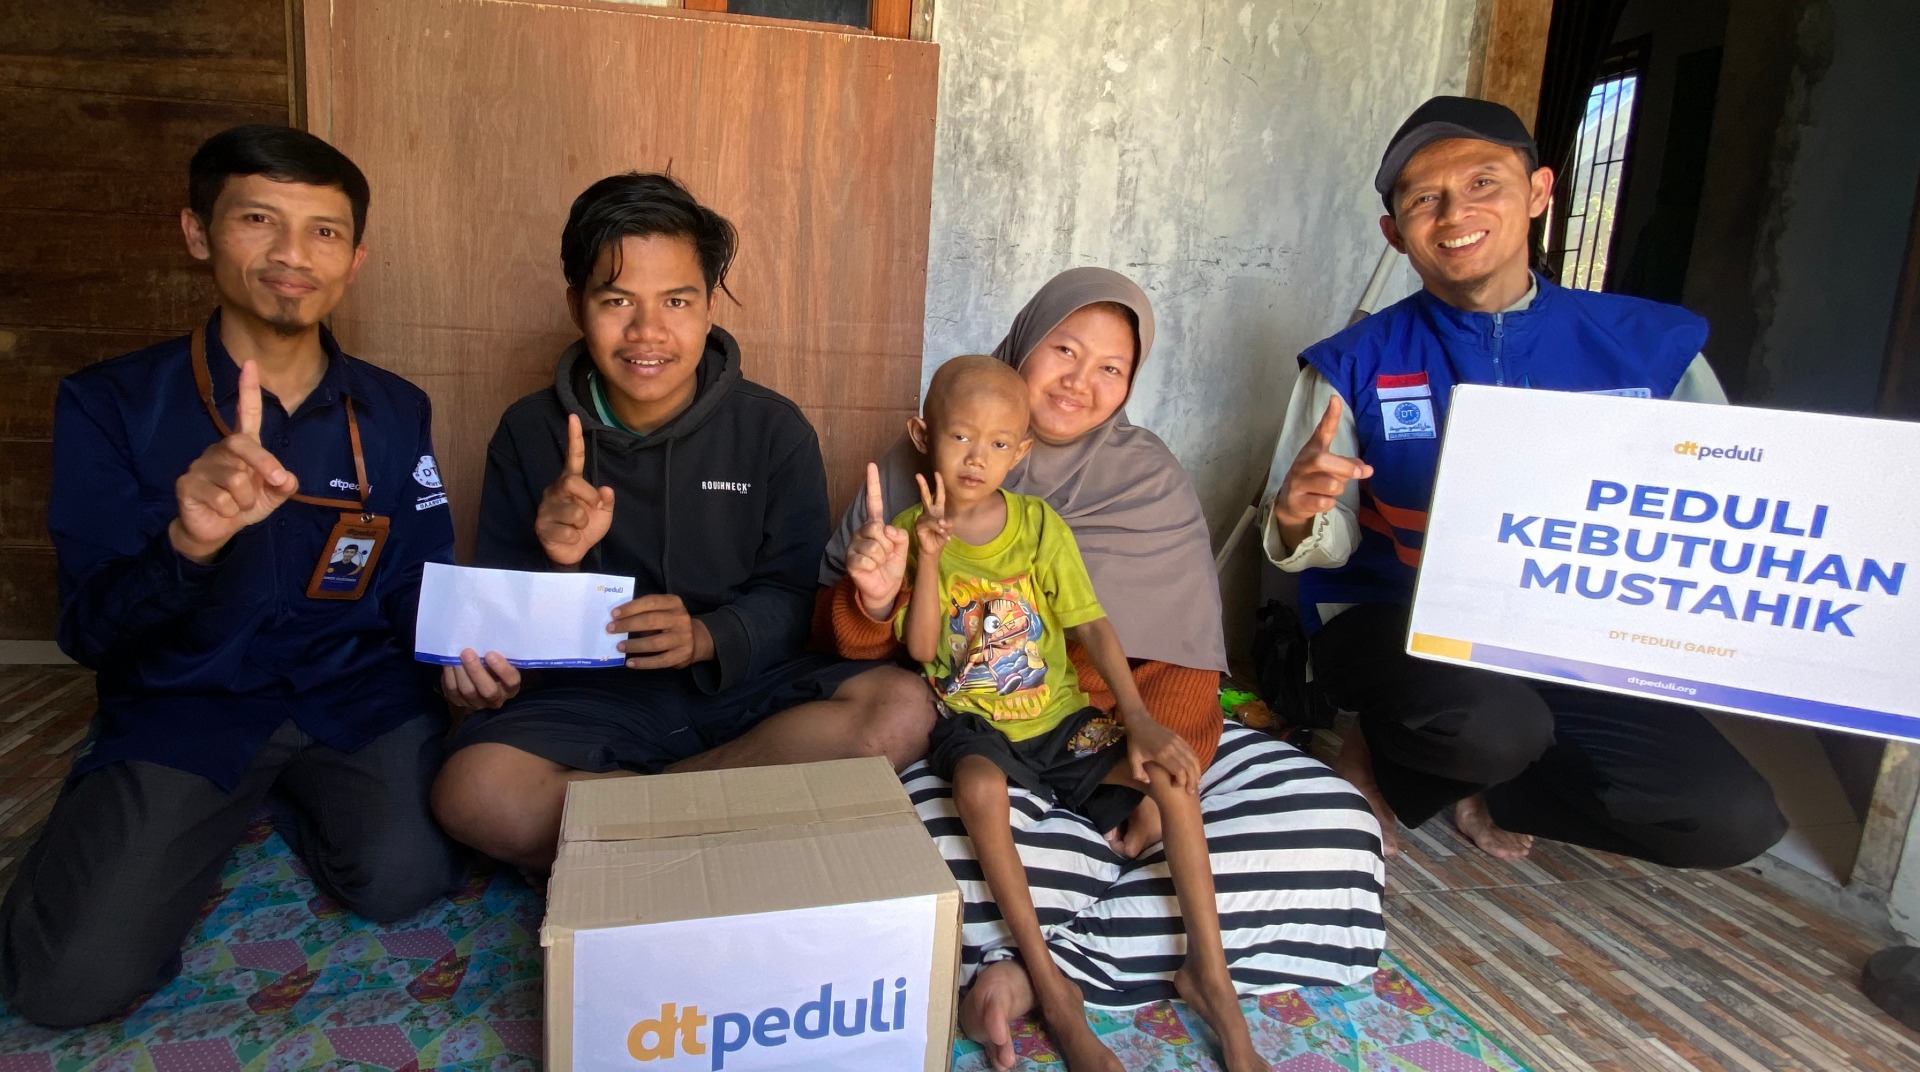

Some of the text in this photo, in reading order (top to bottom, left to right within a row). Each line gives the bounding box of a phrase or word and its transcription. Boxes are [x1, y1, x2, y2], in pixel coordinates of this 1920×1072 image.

[1400, 409, 1414, 418] DT
[1673, 441, 1763, 462] dtpeduli
[1585, 479, 1829, 539] PEDULI
[1497, 512, 1906, 596] KEBUTUHAN
[1519, 558, 1863, 637] MUSTAHIK
[1609, 630, 1738, 658] DT PEDULI GARUT
[1627, 676, 1697, 695] dtpeduli.org
[627, 977, 907, 1071] dtpeduli
